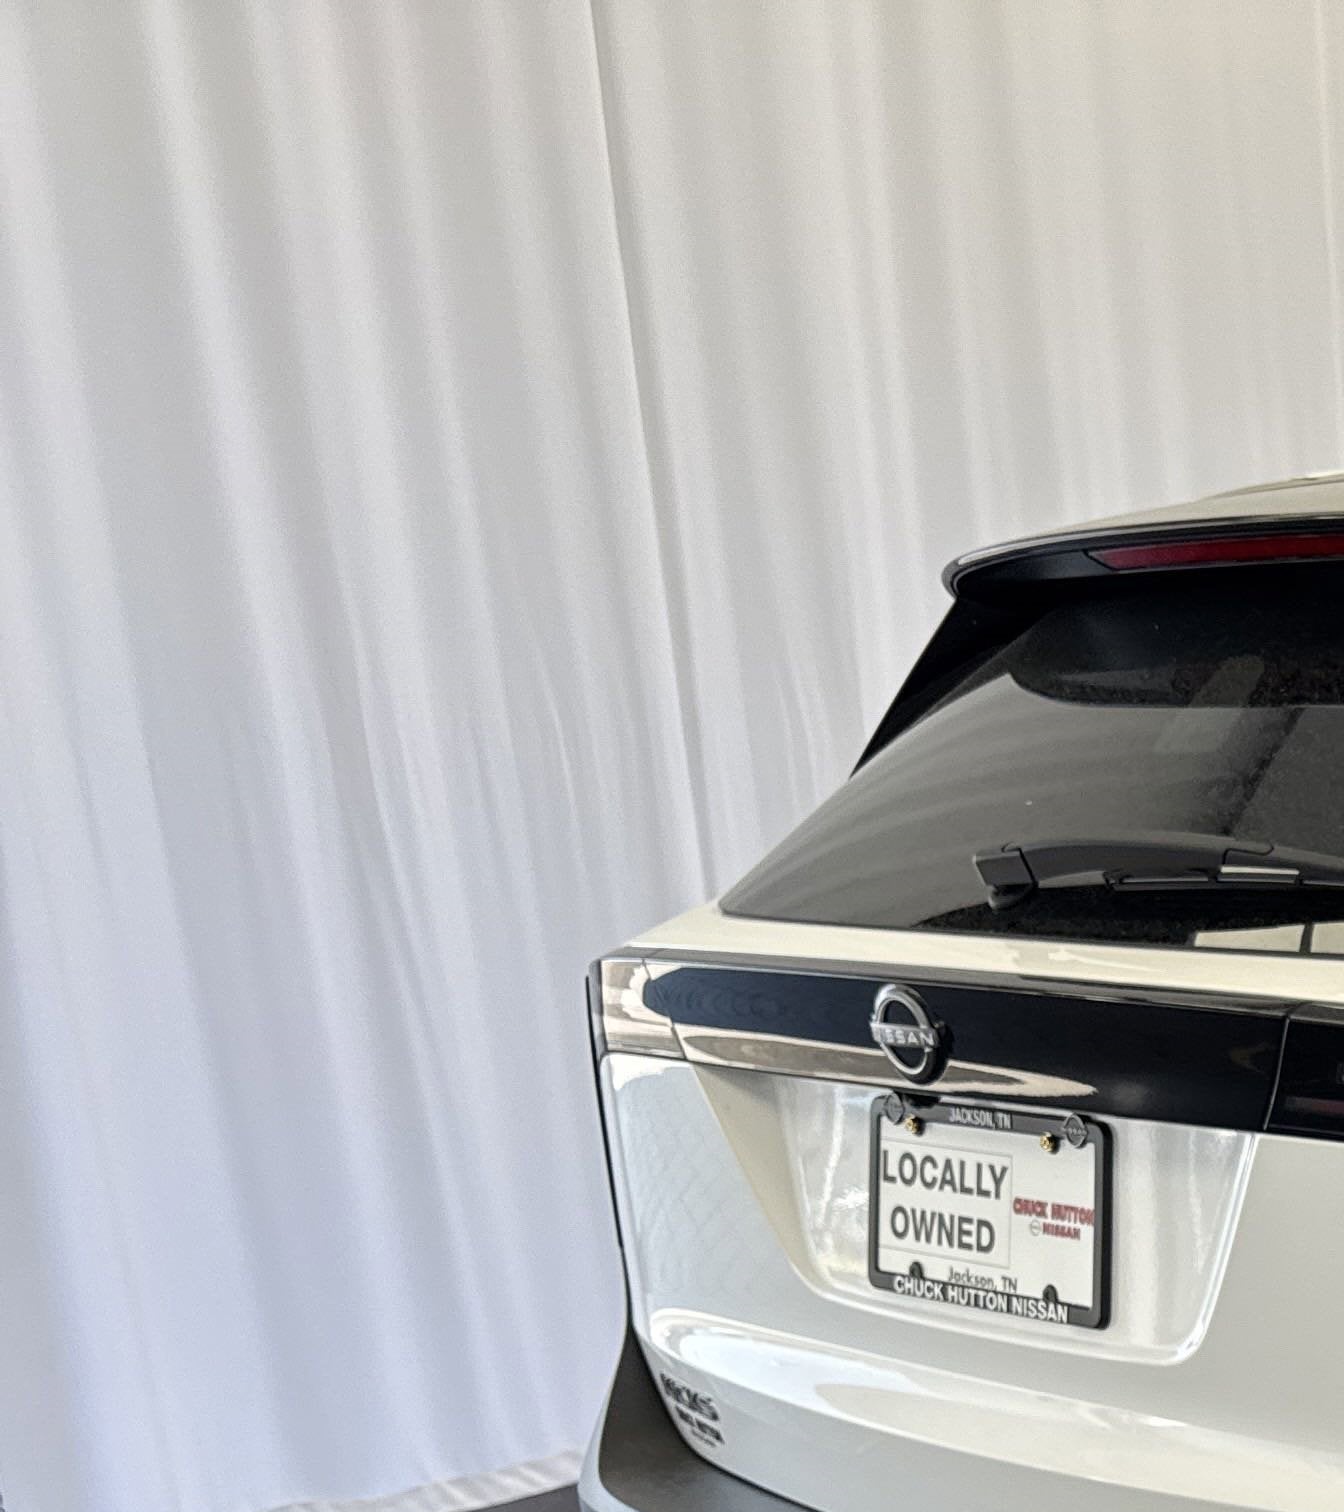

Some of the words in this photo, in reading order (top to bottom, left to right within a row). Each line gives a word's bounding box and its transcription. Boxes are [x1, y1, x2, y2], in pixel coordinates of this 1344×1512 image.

[882, 1149, 1009, 1201] LOCALLY
[890, 1205, 996, 1254] OWNED
[1013, 1197, 1048, 1219] CHUCK
[1051, 1203, 1095, 1227] HUTTON
[1042, 1222, 1081, 1241] NISSAN
[893, 1276, 943, 1301] CHUCK
[947, 1286, 1007, 1314] HUTTON
[1011, 1297, 1069, 1324] NISSAN
[1000, 1275, 1018, 1293] TN
